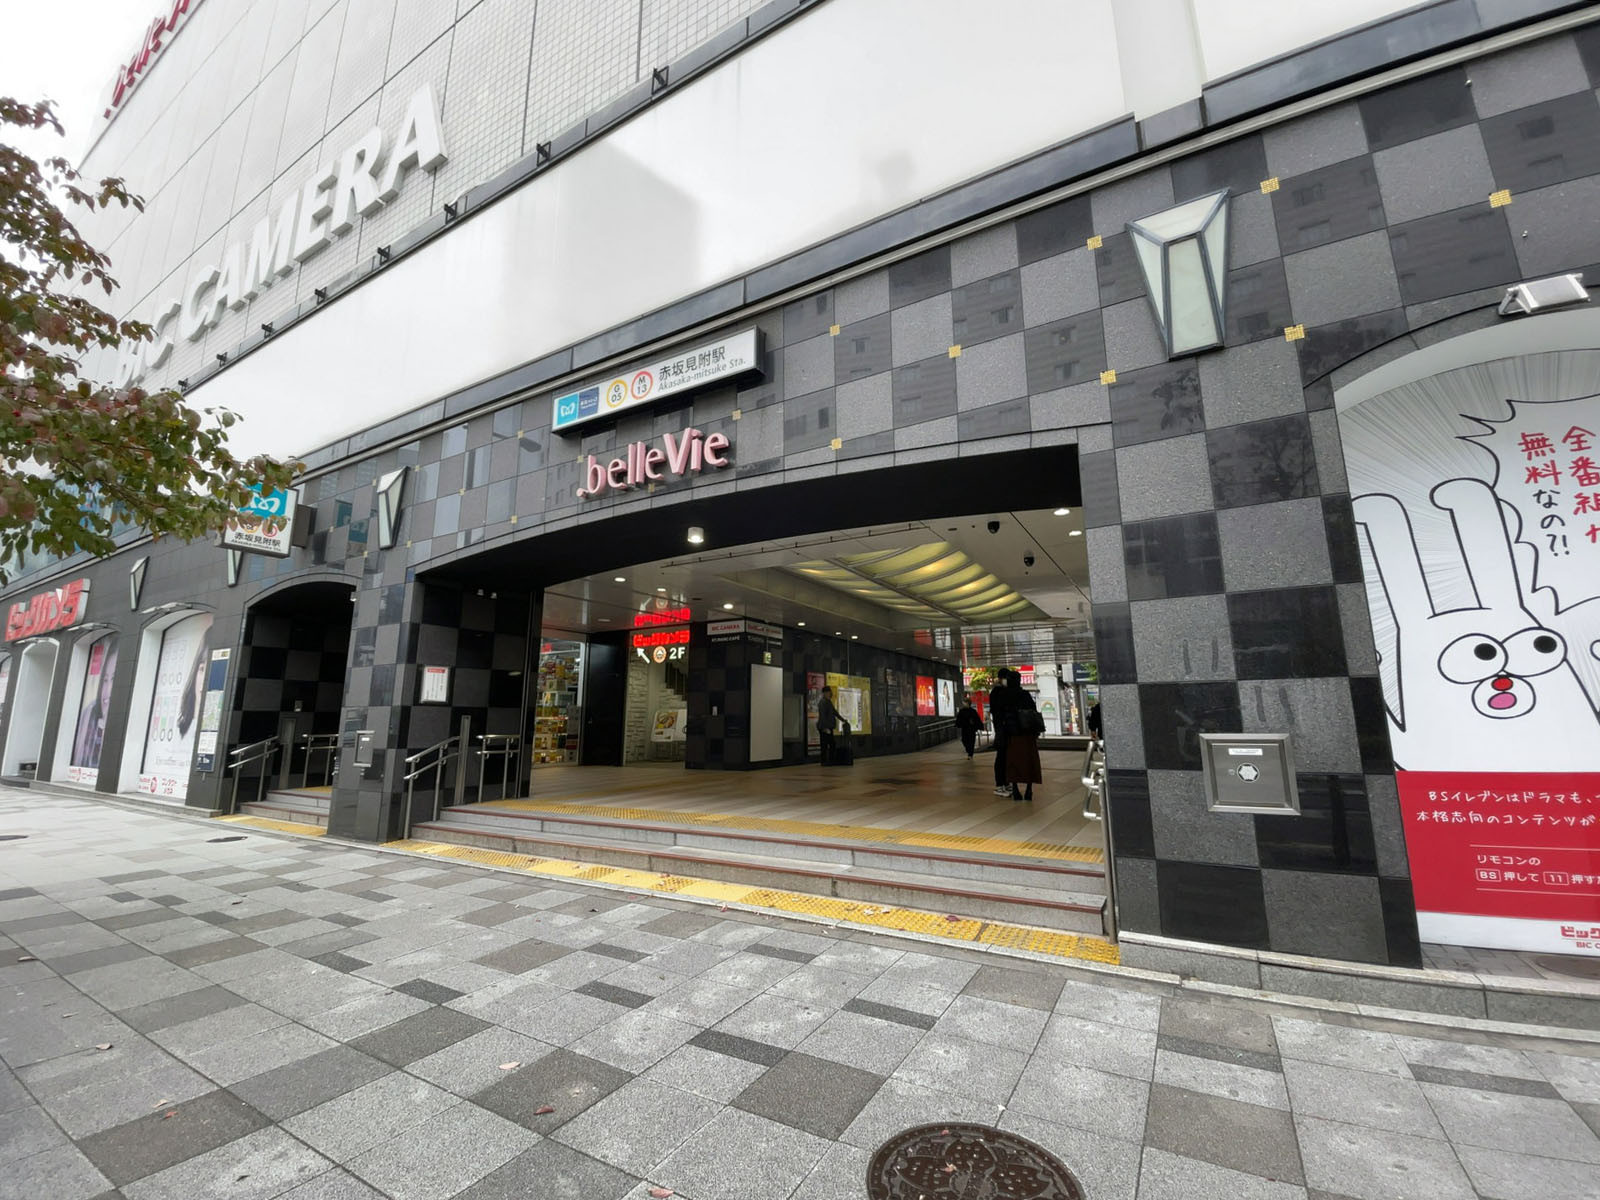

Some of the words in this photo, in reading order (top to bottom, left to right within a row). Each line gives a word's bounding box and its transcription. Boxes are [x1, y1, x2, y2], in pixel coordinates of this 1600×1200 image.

[180, 83, 449, 343] CAMERA
[659, 346, 726, 381] 赤坂見附駅
[638, 376, 647, 386] M
[658, 363, 728, 392] Akasaka-mitsuke
[730, 357, 747, 369] Sta.
[613, 384, 621, 394] G
[637, 384, 648, 395] 13
[611, 392, 623, 404] 05
[234, 532, 281, 548] 赤坂見附駅
[5, 578, 85, 642] ビックカメラ
[669, 646, 686, 660] 2F
[1428, 790, 1600, 805] BSイレブンはドラマも、
[1477, 854, 1541, 866] リモコンの
[1479, 871, 1497, 880] BS
[1503, 871, 1540, 883] 押して
[1550, 874, 1563, 883] 11
